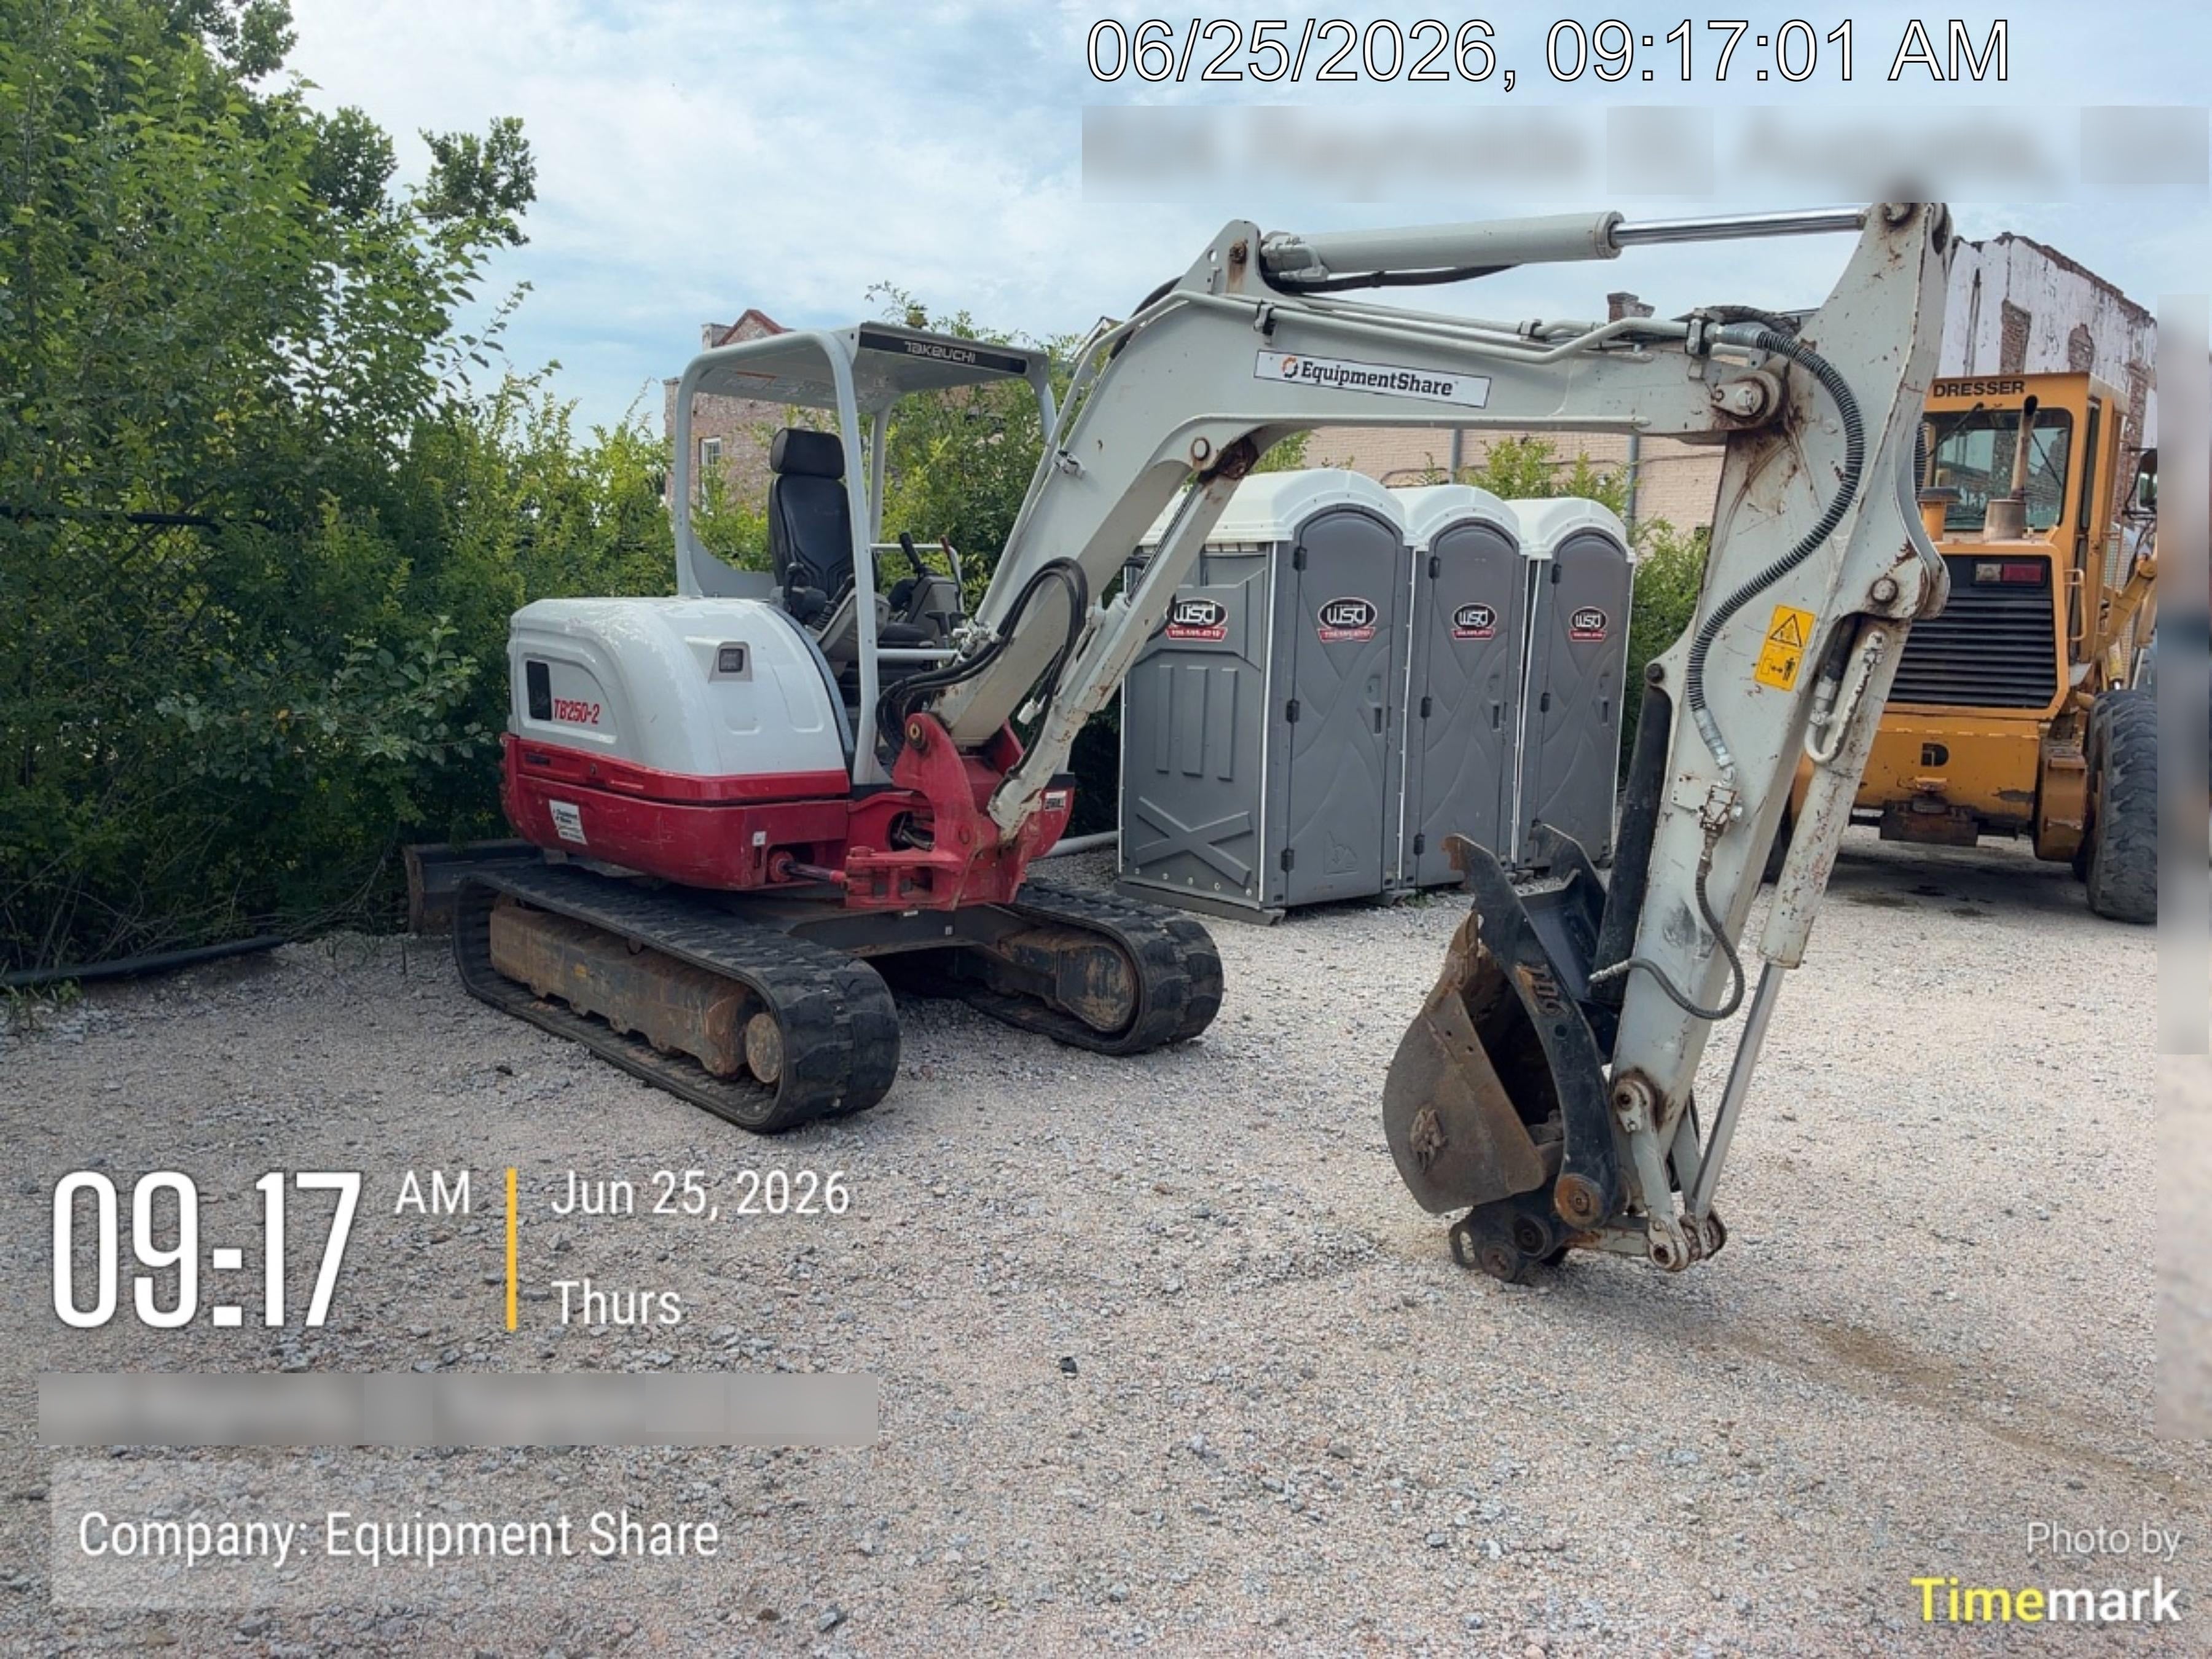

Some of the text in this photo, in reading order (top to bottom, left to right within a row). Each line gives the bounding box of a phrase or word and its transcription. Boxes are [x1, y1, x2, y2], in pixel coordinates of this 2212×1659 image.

[1301, 360, 1453, 396] EquipmentShare
[1933, 380, 2025, 397] DRESSER
[554, 699, 600, 724] TB250-2
